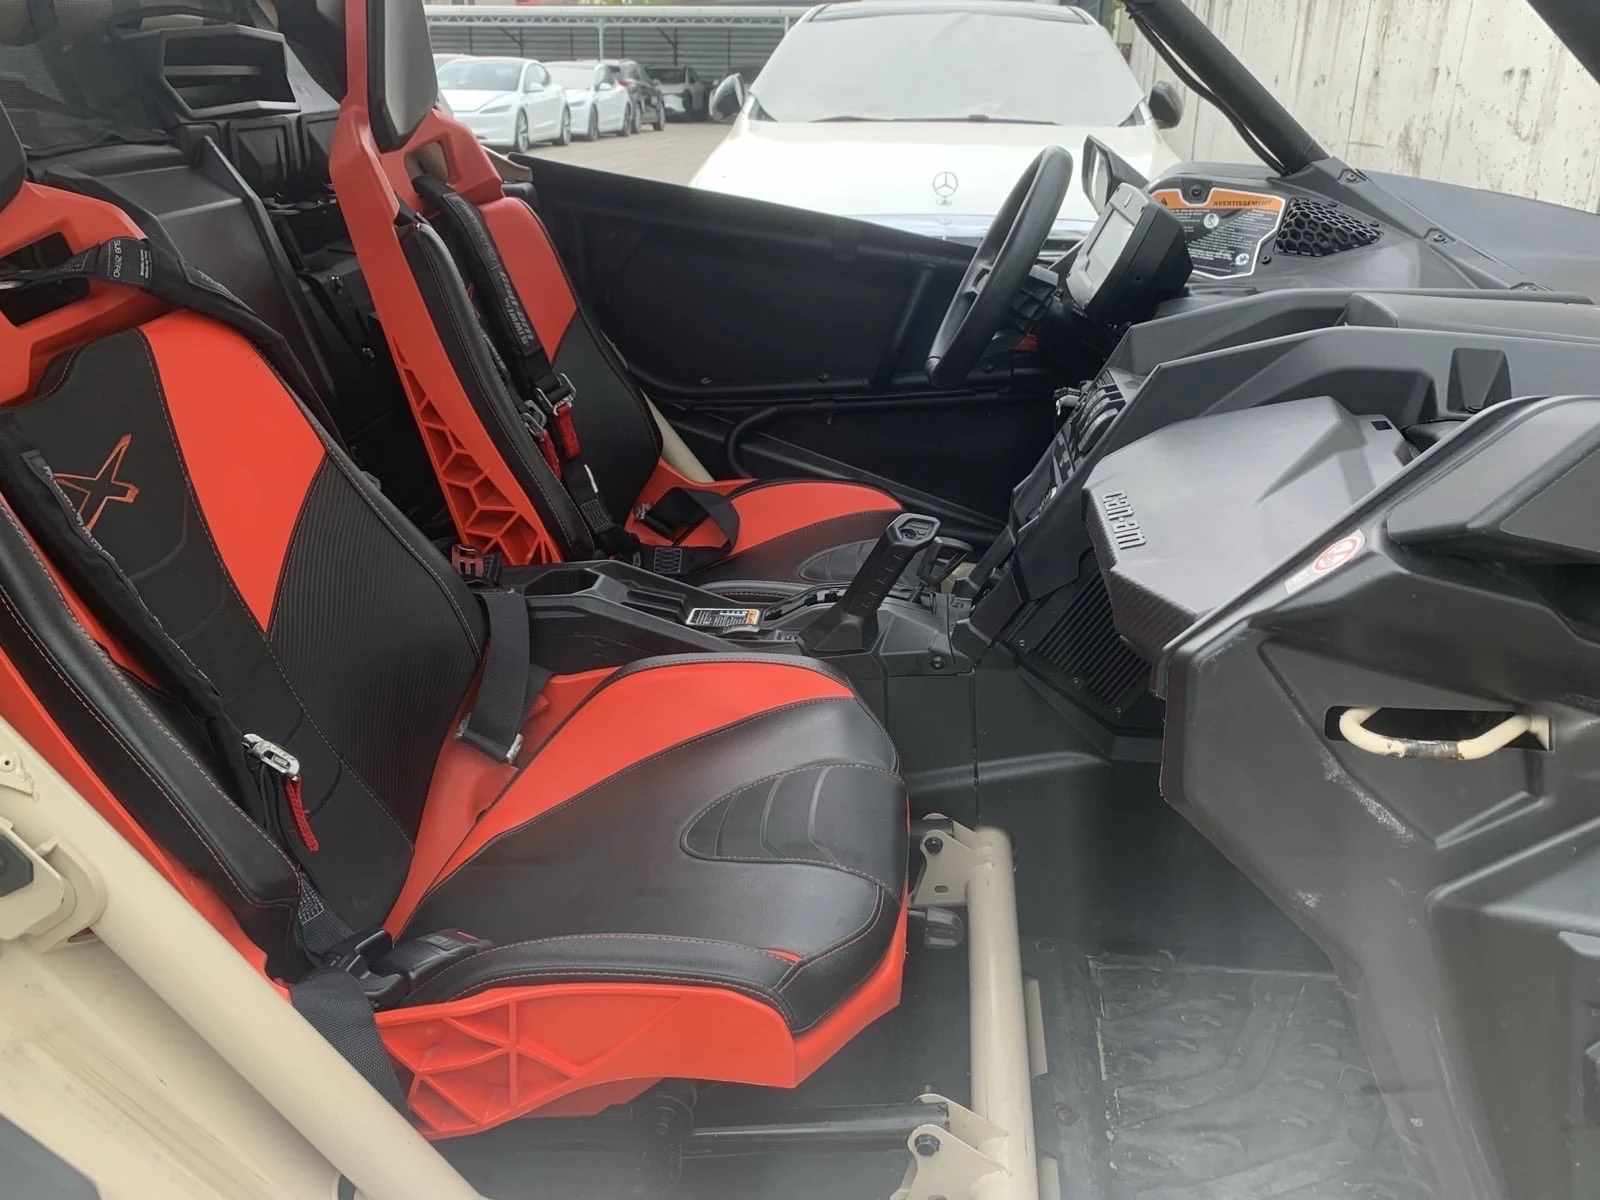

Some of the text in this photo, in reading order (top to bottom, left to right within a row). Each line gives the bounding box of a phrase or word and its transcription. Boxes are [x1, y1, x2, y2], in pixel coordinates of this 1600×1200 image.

[113, 240, 122, 278] SUB ZERO
[1102, 490, 1147, 550] can-am
